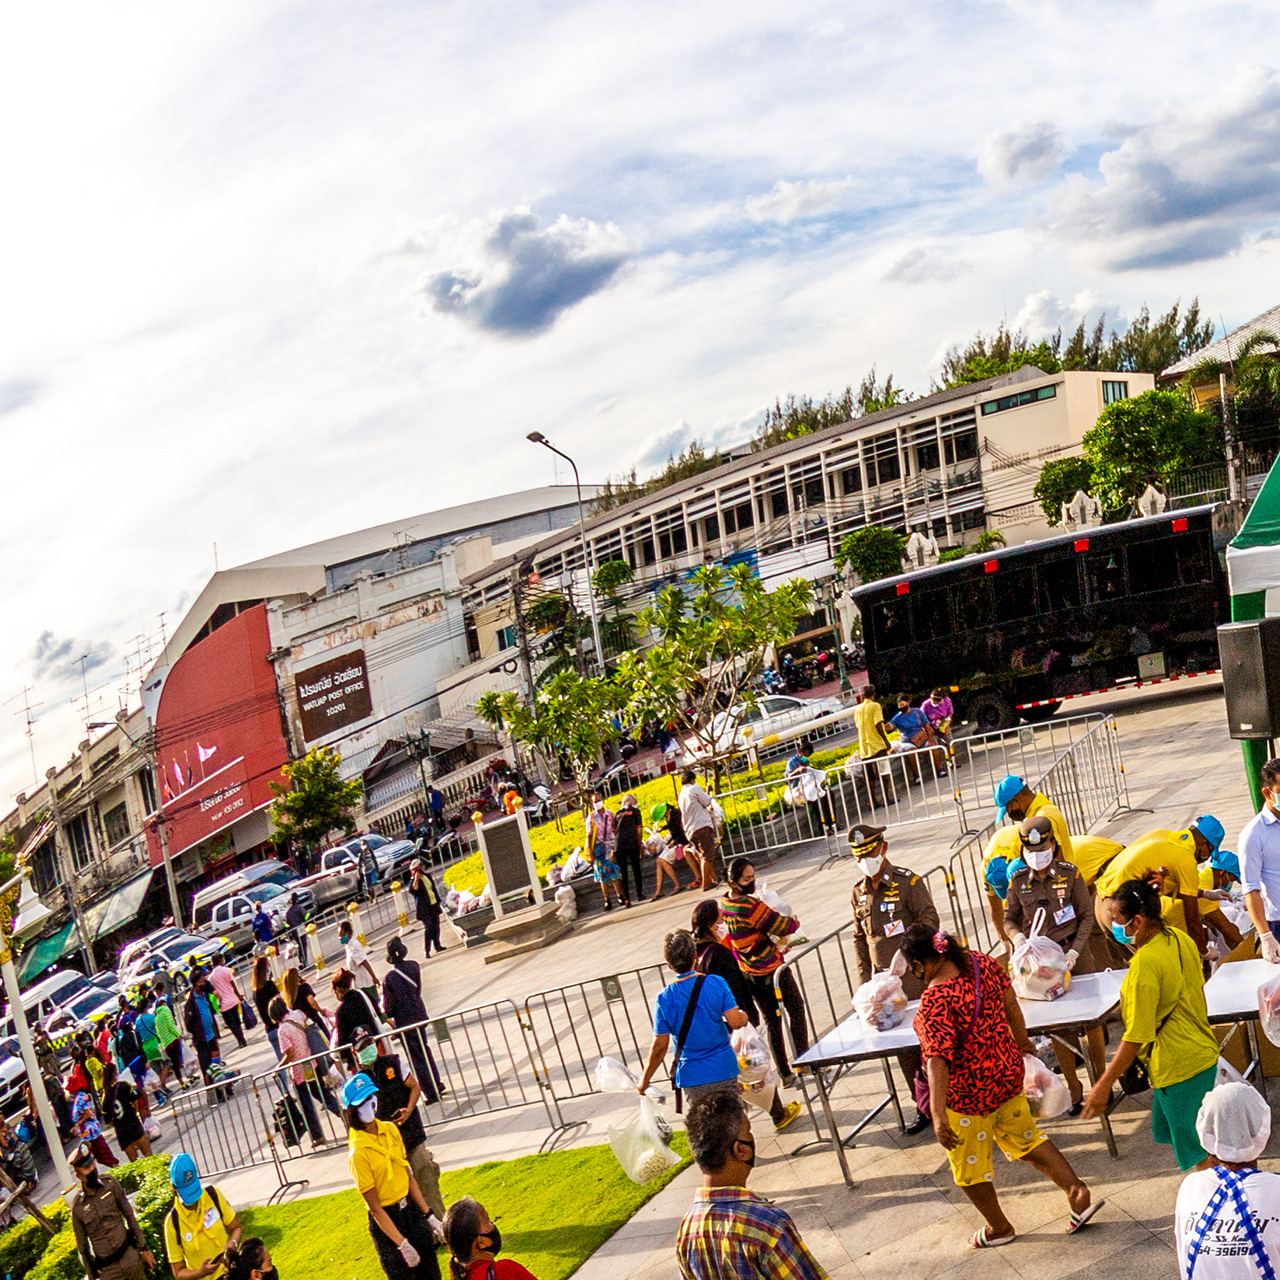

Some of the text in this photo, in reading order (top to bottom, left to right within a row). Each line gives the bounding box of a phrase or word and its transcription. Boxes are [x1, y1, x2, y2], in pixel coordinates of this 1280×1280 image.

[328, 689, 344, 701] POST
[344, 681, 364, 694] OFFICE
[326, 703, 346, 717] 10201
